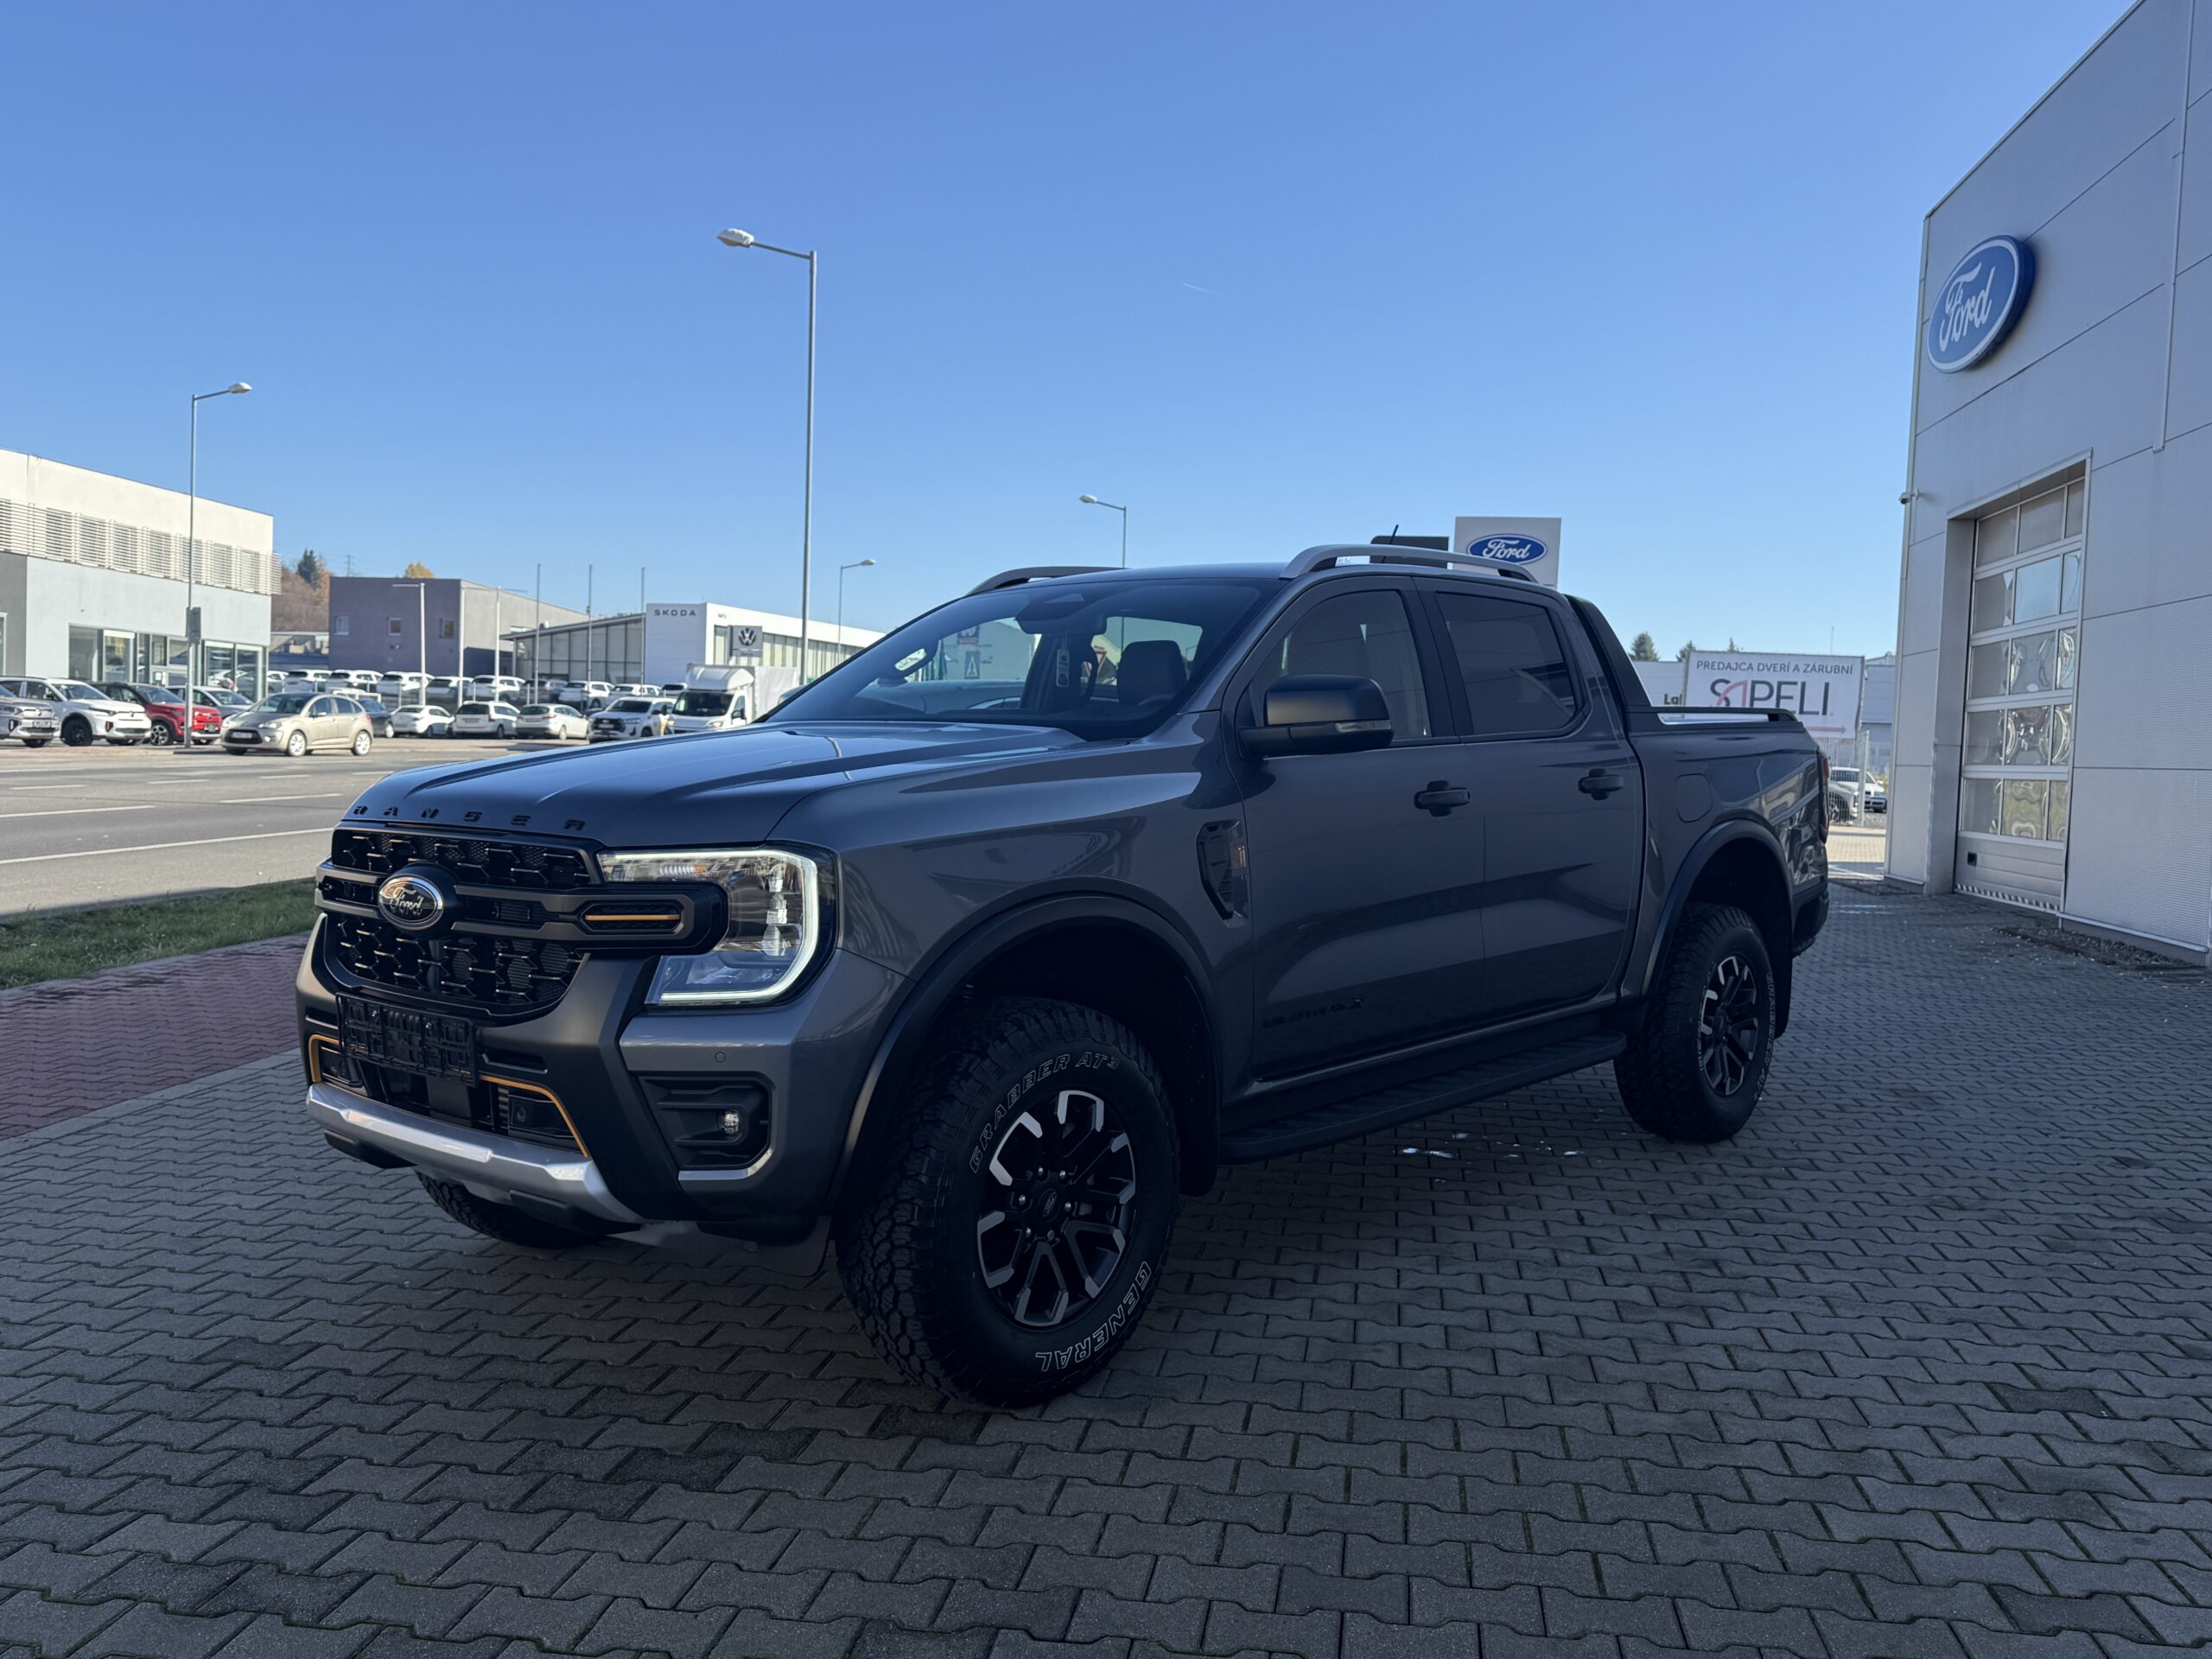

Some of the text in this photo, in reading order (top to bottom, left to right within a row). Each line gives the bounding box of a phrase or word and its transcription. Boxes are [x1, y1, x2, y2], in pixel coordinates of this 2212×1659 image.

[1939, 262, 1996, 352] Ford
[1482, 538, 1532, 559] Ford
[1696, 660, 1854, 675] PREDAJCA DVERÍ A ZÁRUBNÍ
[352, 805, 587, 831] RANGER
[389, 887, 424, 916] Ford
[969, 1052, 1071, 1174] GRABBER
[1034, 1260, 1153, 1373] GENERAL
